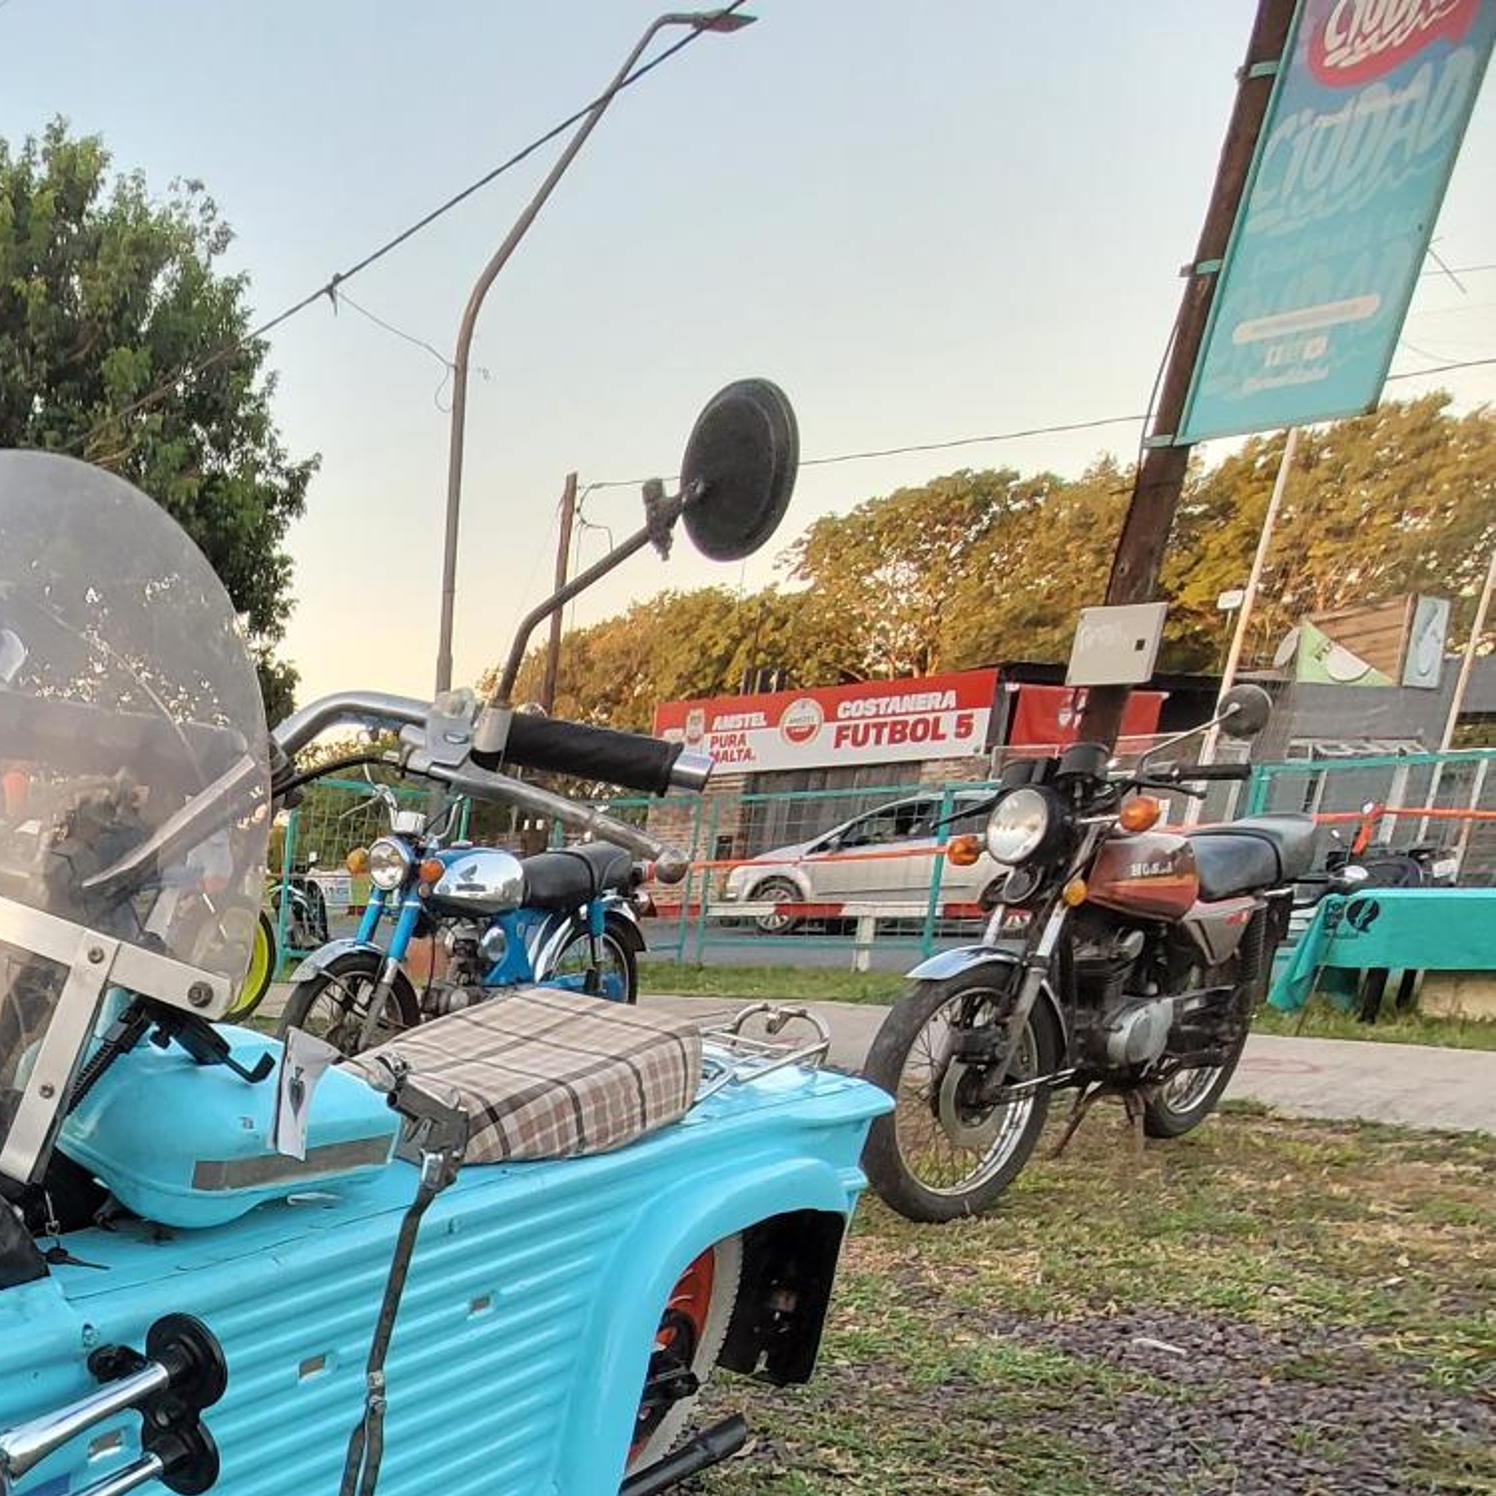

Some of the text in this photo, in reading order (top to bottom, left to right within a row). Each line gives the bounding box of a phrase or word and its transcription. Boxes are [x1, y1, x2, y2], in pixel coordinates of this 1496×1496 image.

[837, 690, 956, 719] COSTANERA
[712, 711, 768, 731] AMSTEL
[833, 713, 974, 749] FUTBOL 5
[709, 733, 747, 749] PURA
